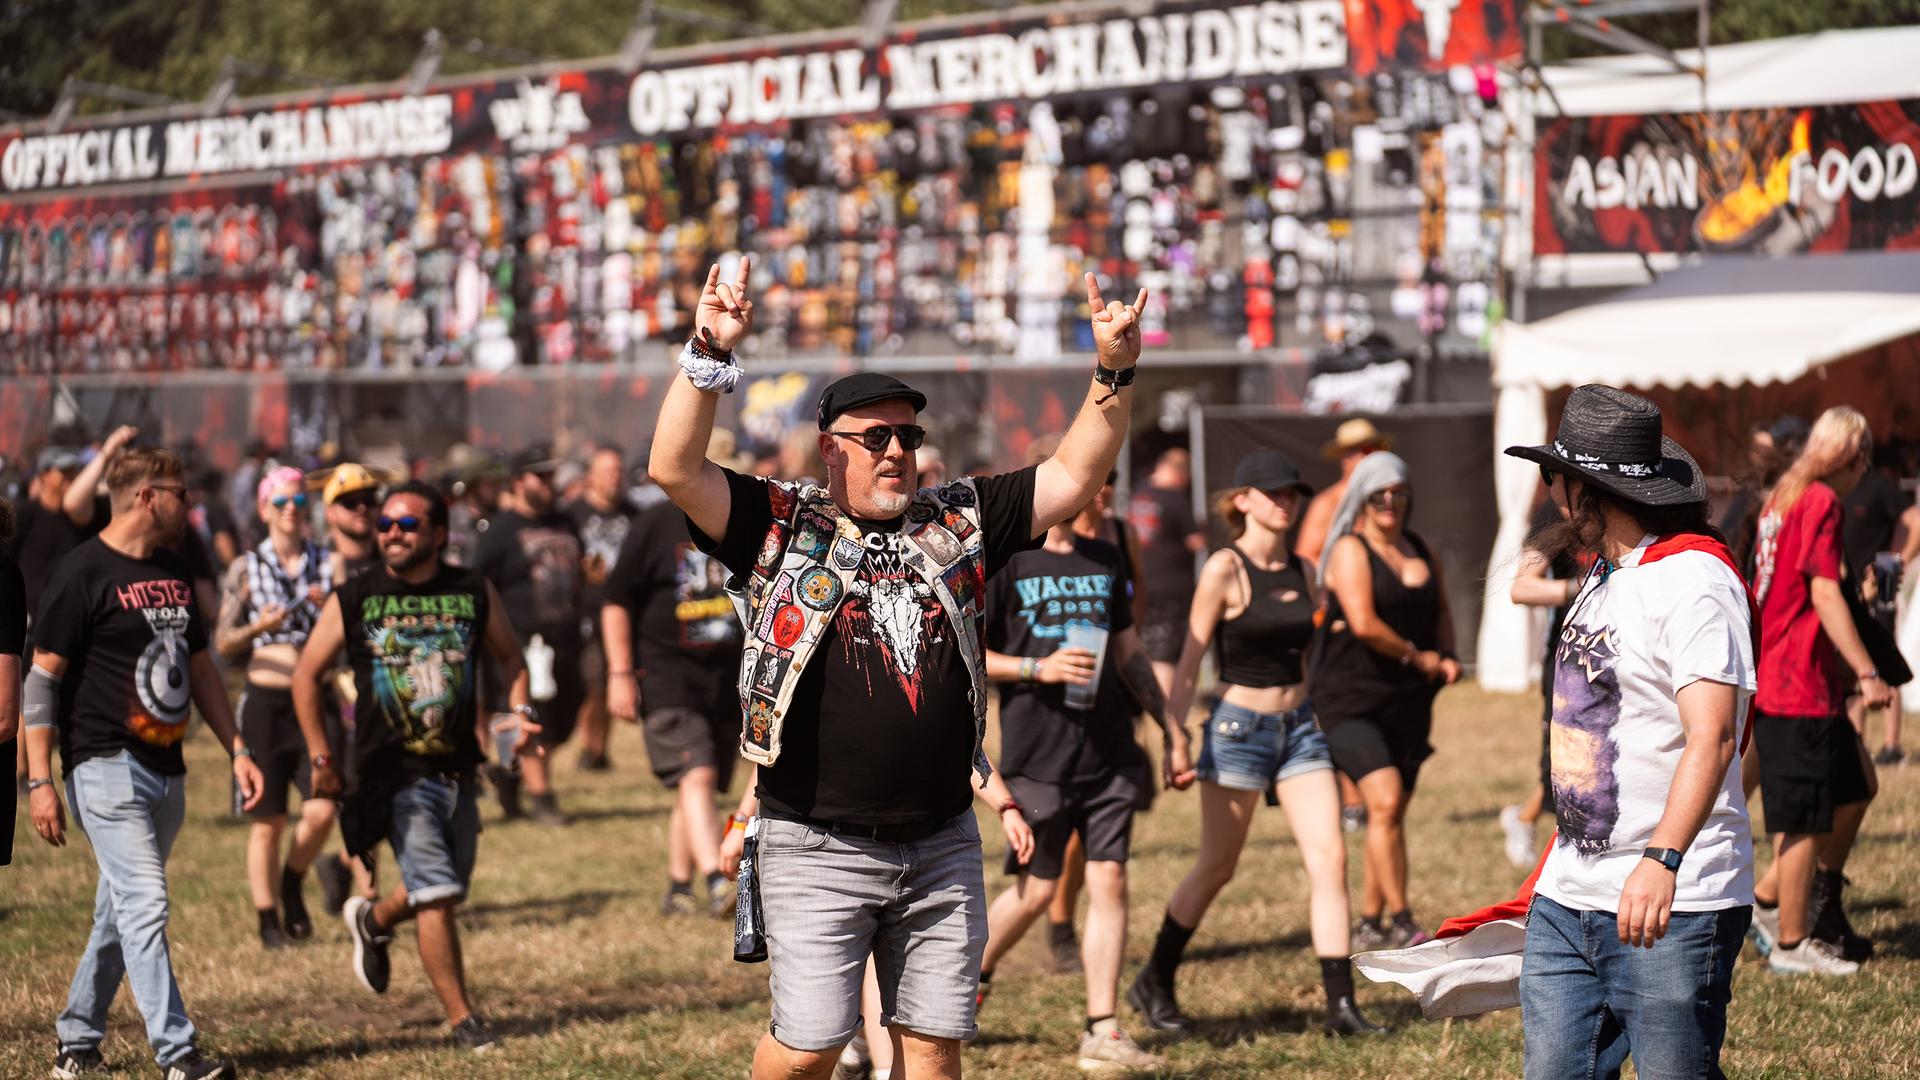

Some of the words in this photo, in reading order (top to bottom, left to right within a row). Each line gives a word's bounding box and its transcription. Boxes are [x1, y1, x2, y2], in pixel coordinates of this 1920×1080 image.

[629, 49, 881, 136] OFFICIAL
[884, 1, 1348, 110] MERCHANDISE
[2, 126, 159, 191] OFFICIAL
[164, 94, 453, 177] MERCHANDISE
[1564, 153, 1698, 209] ASIAN
[1788, 143, 1918, 205] FOOD
[362, 594, 476, 622] WACKEN
[1046, 600, 1105, 616] 2024
